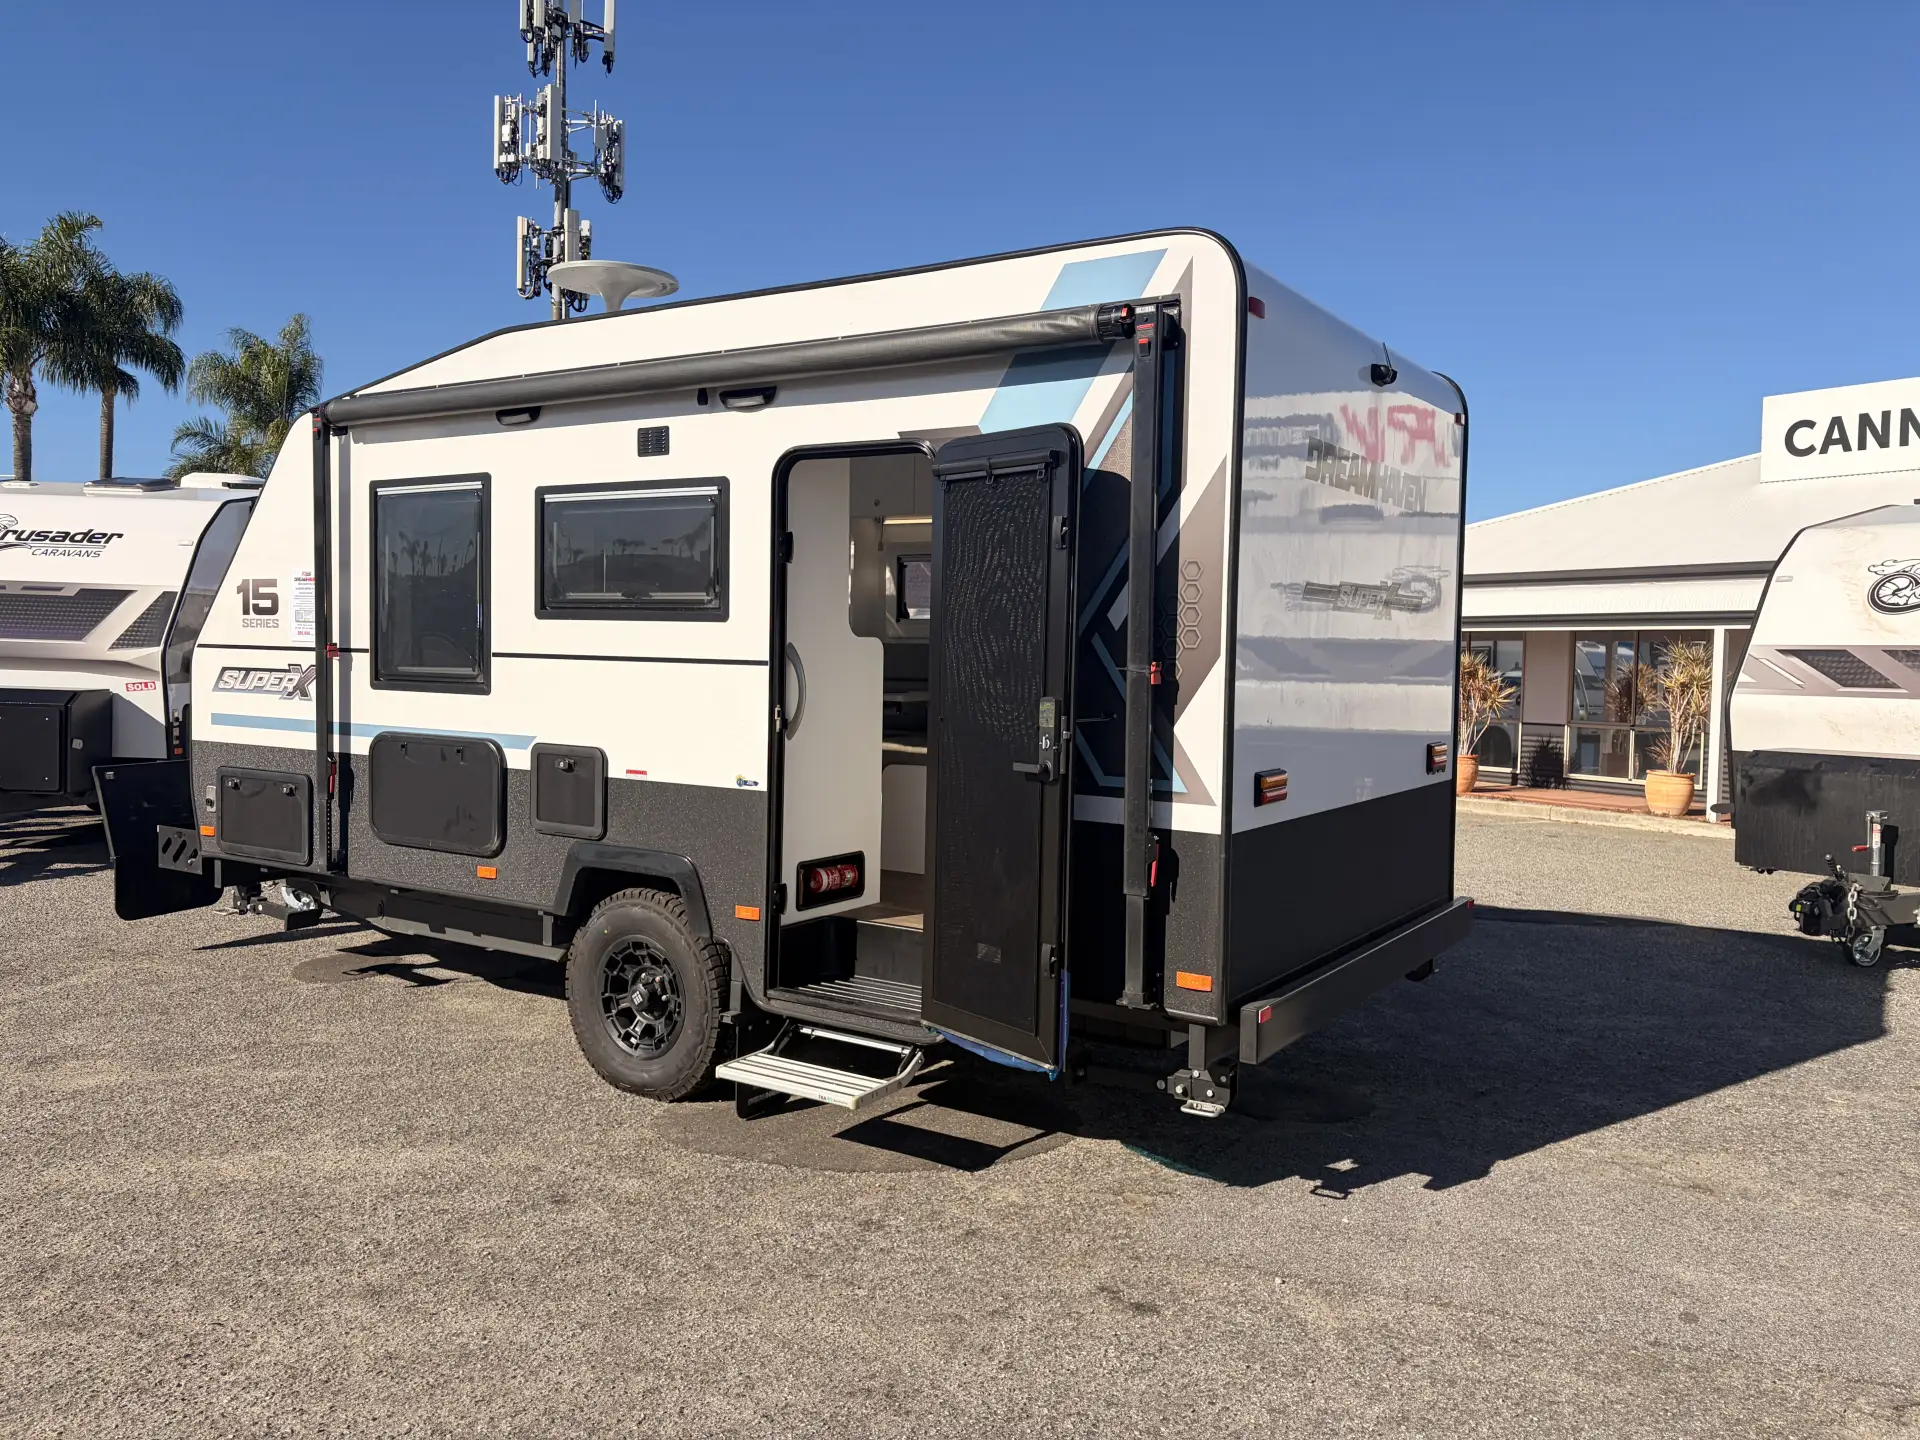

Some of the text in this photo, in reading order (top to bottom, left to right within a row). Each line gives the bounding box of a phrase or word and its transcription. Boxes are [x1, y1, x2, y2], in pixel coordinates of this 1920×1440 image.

[1784, 407, 1920, 457] CANN
[1304, 436, 1428, 512] DREAMHAVEN
[0, 528, 124, 545] rusader
[31, 548, 103, 558] CARAVANS
[237, 578, 279, 616] 15
[242, 618, 280, 629] SERIES
[127, 682, 156, 691] SOLD
